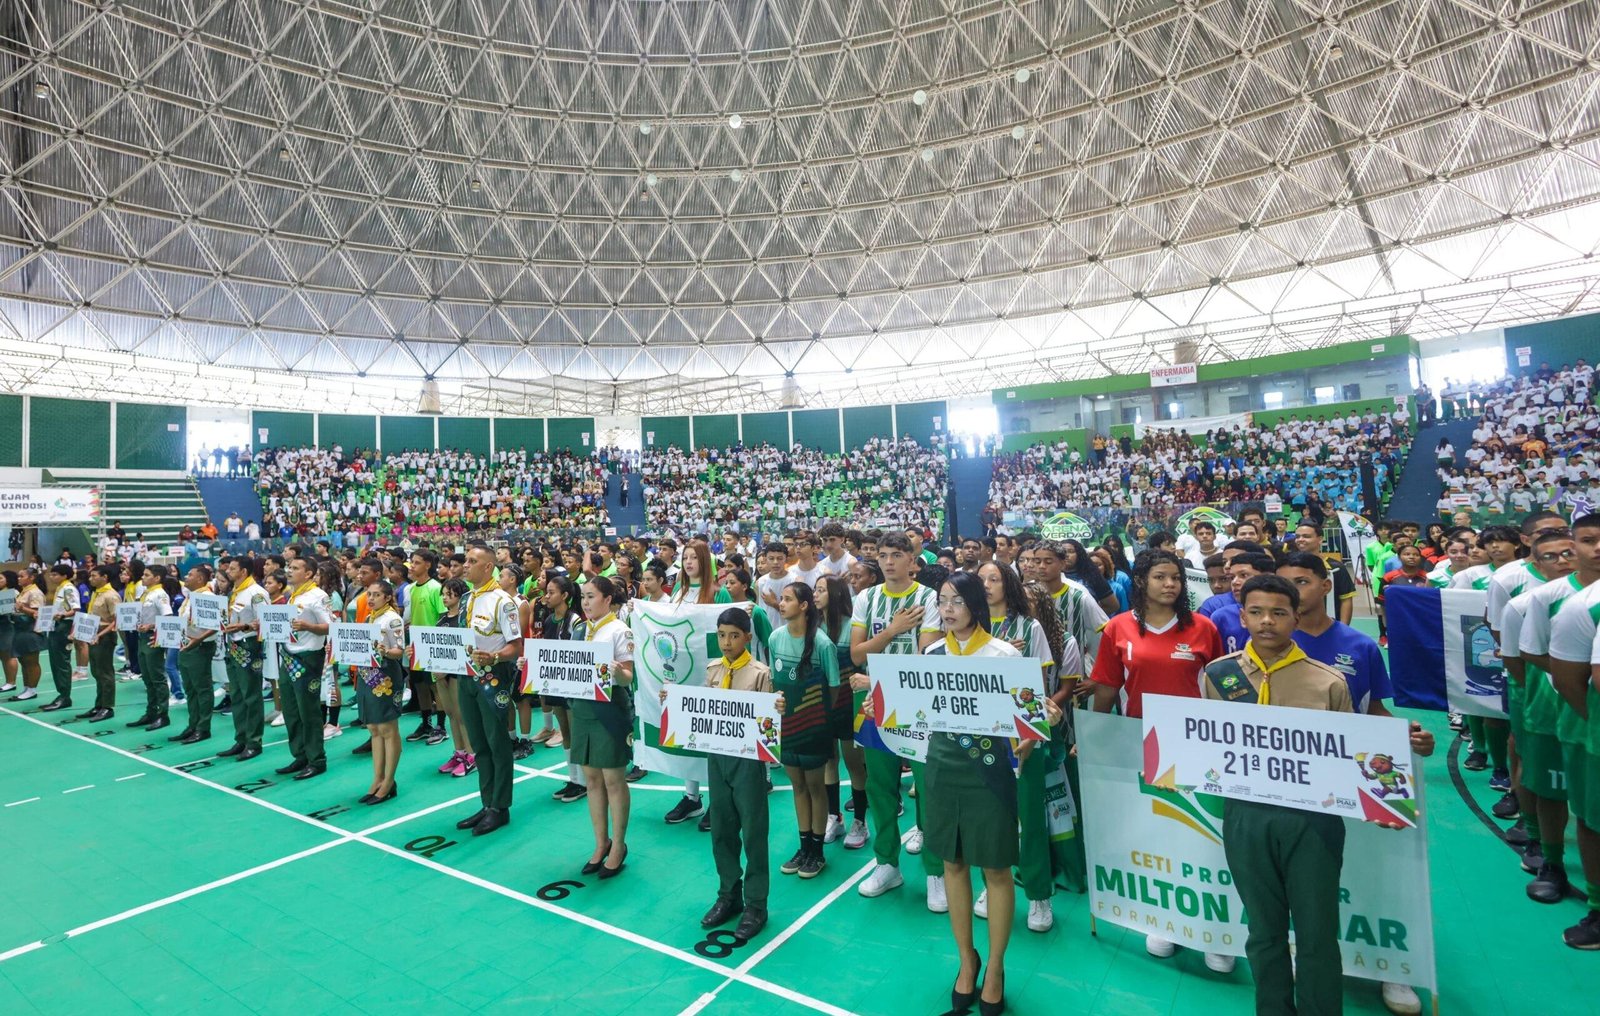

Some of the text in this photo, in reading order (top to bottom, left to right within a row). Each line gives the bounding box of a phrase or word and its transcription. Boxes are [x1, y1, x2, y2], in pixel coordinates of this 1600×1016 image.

[1151, 366, 1195, 377] ENFERMARIA
[203, 600, 219, 609] REGIONAL
[196, 610, 217, 619] PAULISTANA
[263, 612, 289, 622] POLO REGIONAL
[338, 629, 371, 640] POLO REGIONAL
[421, 632, 464, 647] POLO REGIONAL
[350, 642, 369, 653] CORREIA
[430, 646, 457, 660] FLORIANO
[539, 649, 596, 666] POLO REGIONAL
[540, 665, 593, 683] CAMPO MAIOR
[898, 671, 1009, 694] POLO REGIONAL
[682, 697, 756, 719] POLO REGIONAL
[931, 695, 979, 716] 4ª GRE
[691, 717, 745, 738] BOM JESUS
[1184, 717, 1354, 760] POLO REGIONAL
[1223, 750, 1311, 785] 21ª GRE
[1130, 850, 1172, 874] CETI
[1095, 864, 1230, 923] MILTON
[1097, 900, 1233, 945] FORMANDO
[694, 930, 748, 958] 8
